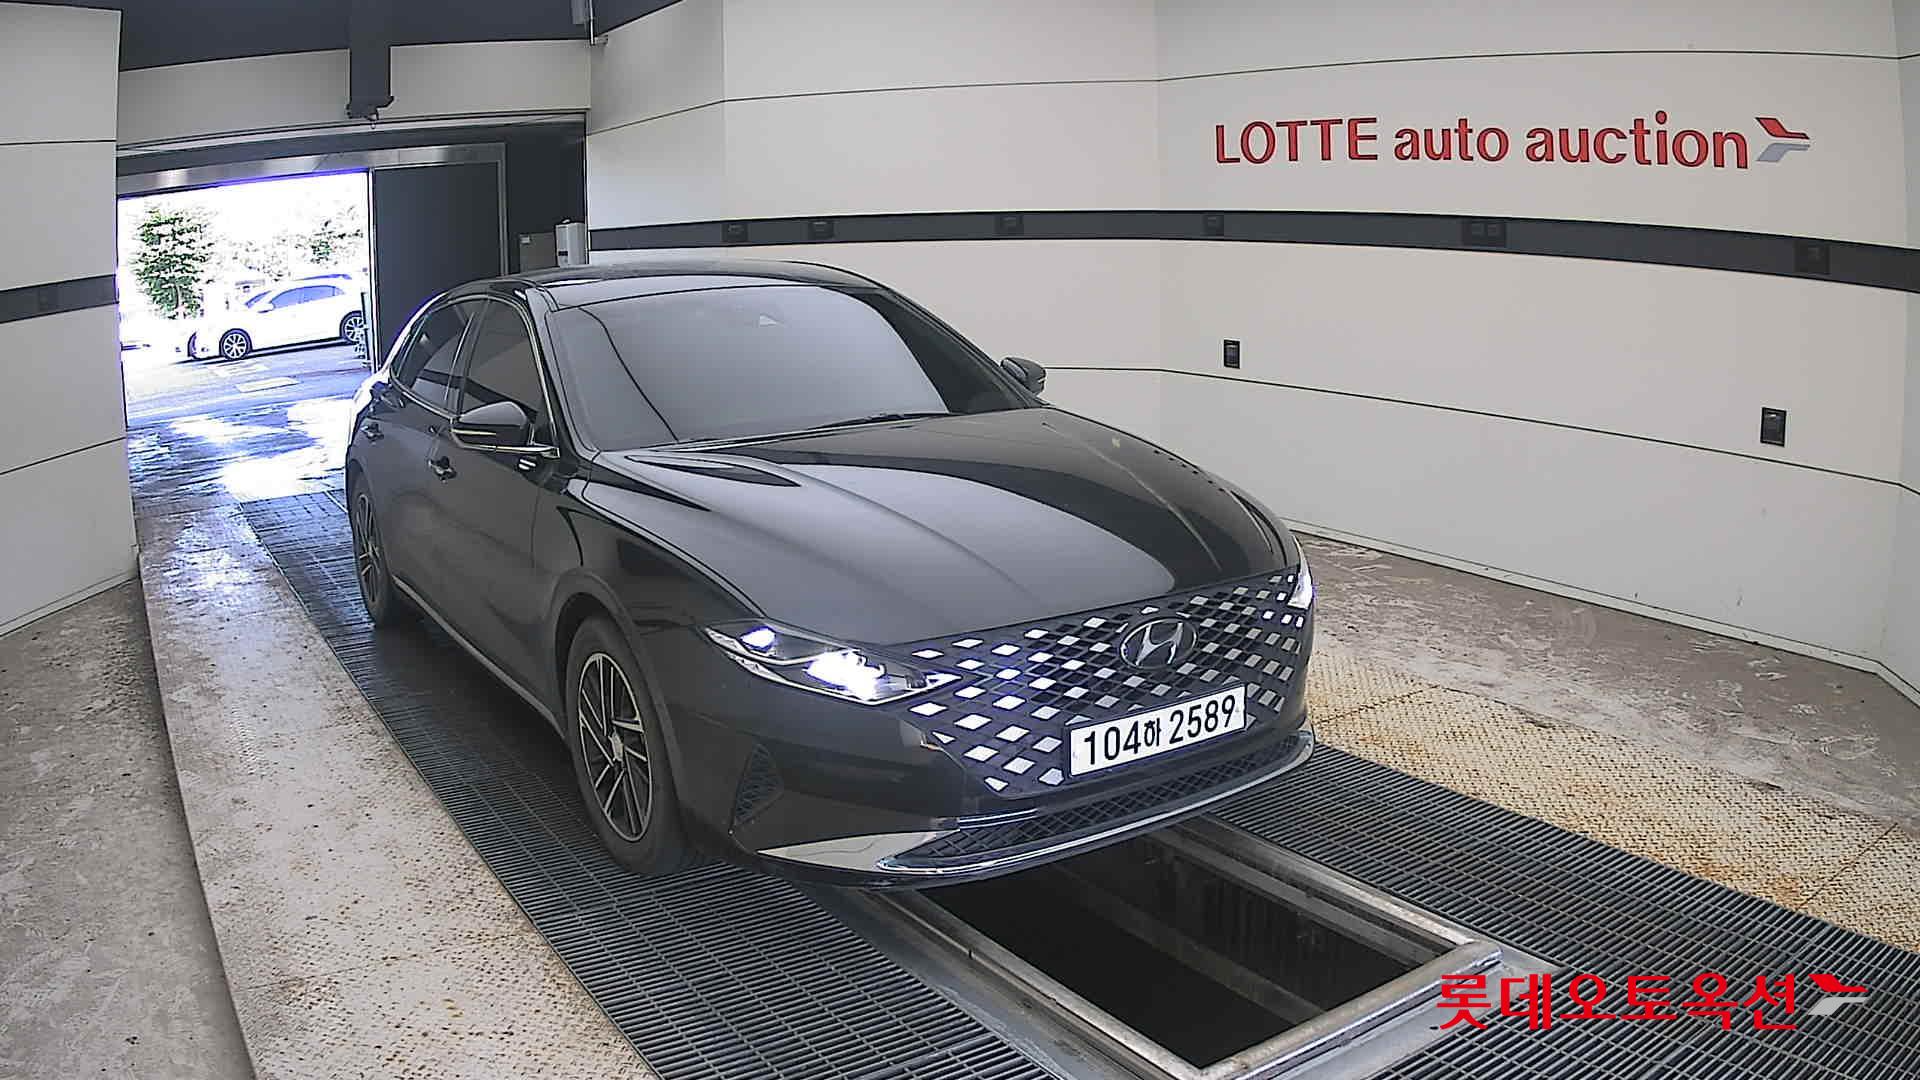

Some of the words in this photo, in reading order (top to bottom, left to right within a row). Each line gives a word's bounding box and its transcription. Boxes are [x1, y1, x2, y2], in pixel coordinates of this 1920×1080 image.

[1215, 117, 1378, 165] LOTTE
[1393, 117, 1509, 163] auto
[1525, 110, 1749, 169] auction
[1084, 717, 1162, 766] 104하
[1169, 694, 1237, 745] 2589
